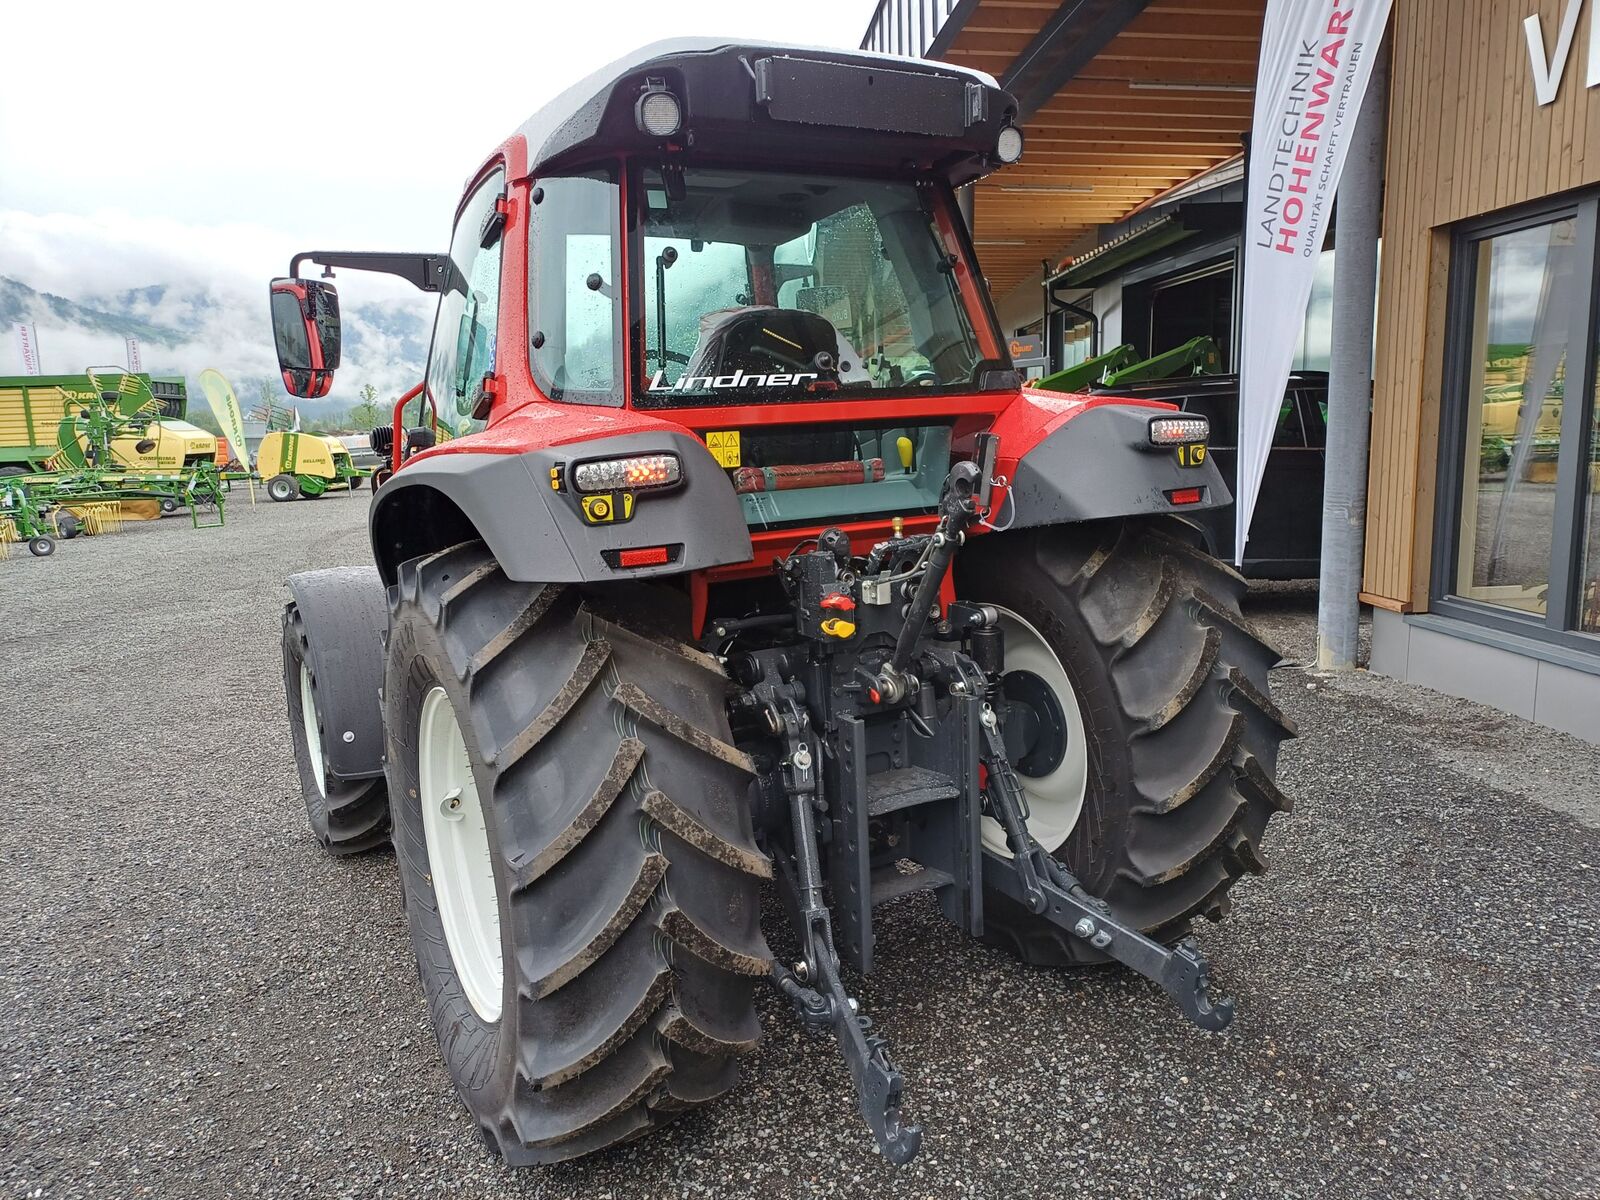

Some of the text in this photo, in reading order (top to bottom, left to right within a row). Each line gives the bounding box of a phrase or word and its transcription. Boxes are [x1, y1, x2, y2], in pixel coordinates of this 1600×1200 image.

[1257, 40, 1319, 248] LANDTECHNIK
[1275, 0, 1354, 254] HOHENWAR
[1303, 42, 1364, 257] QUALITÄT SCHAFFT VERTRAUEN
[648, 369, 819, 393] Lindner
